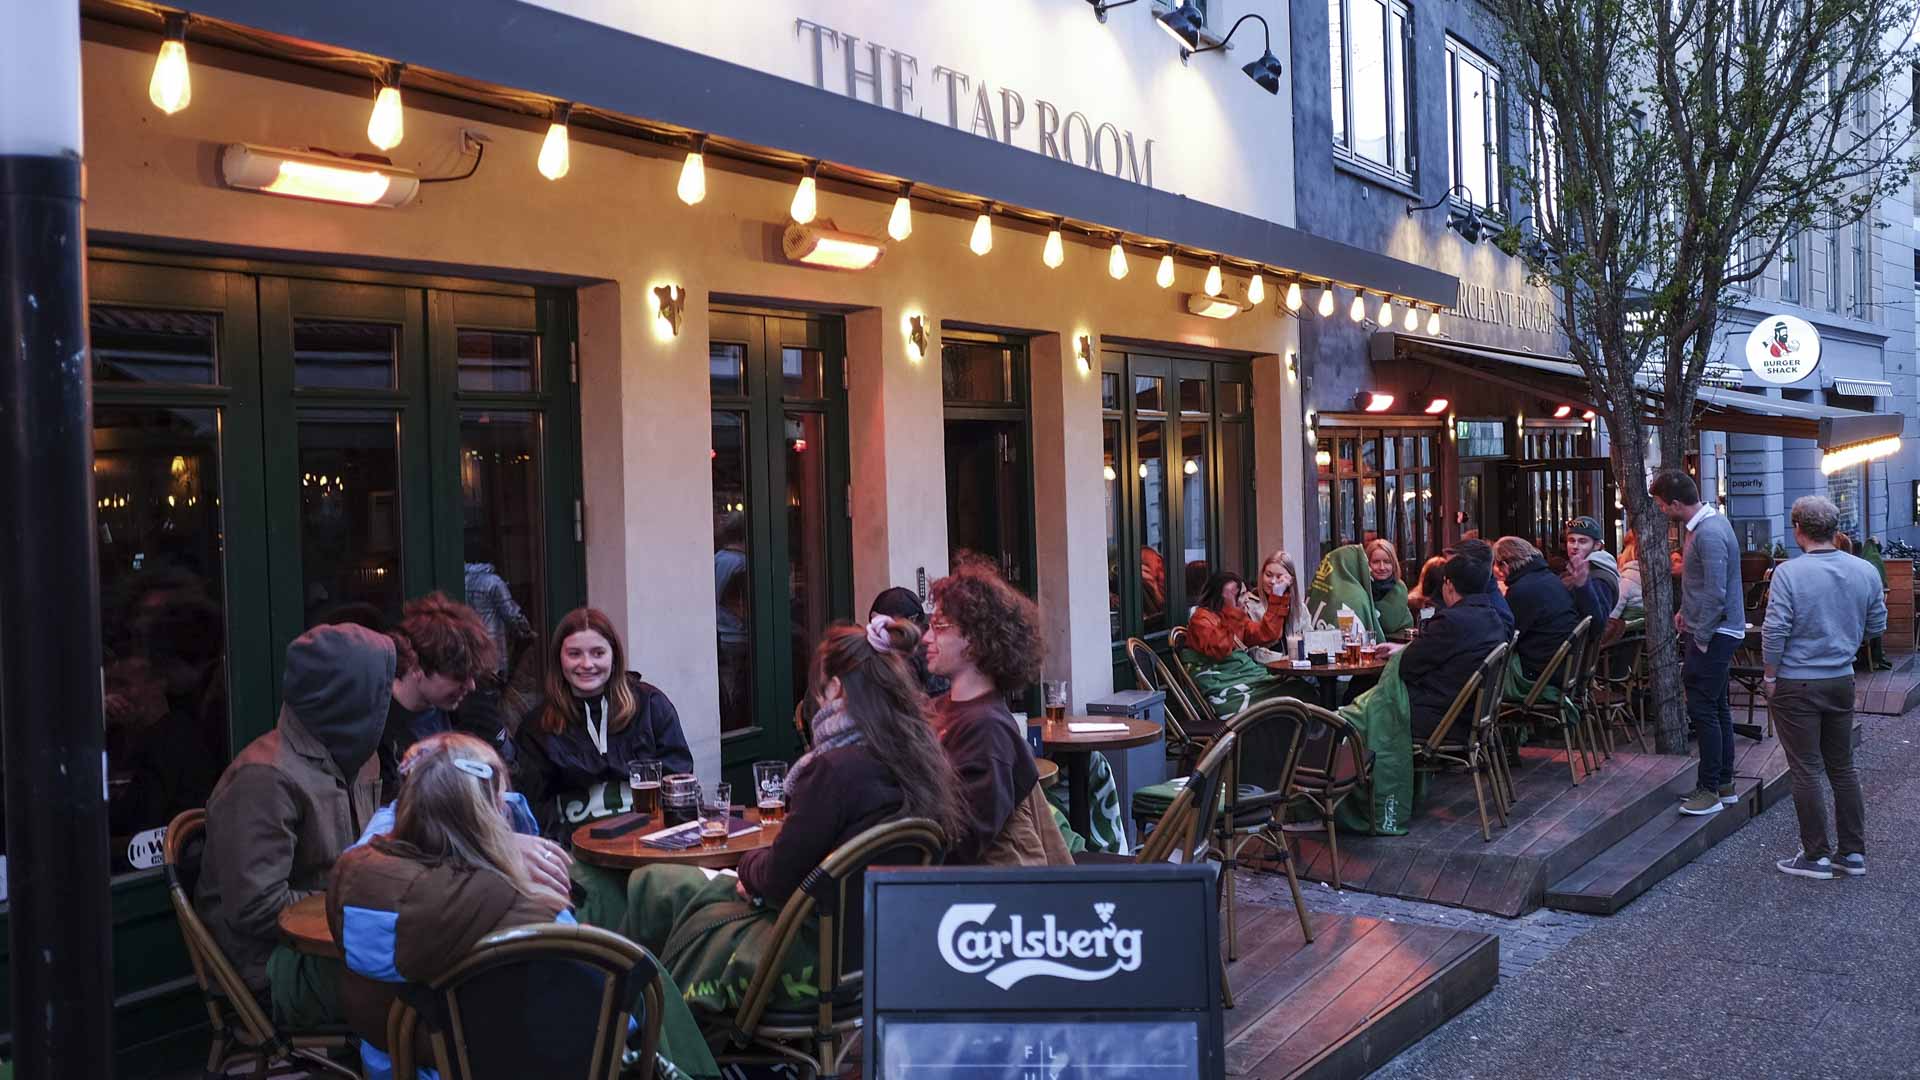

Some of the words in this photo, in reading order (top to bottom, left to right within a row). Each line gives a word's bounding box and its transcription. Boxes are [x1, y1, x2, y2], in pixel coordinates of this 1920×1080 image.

[795, 17, 922, 118] THE
[933, 65, 1025, 146] TAP
[1034, 99, 1156, 188] ROOM
[1763, 359, 1801, 367] BURGER
[1767, 366, 1798, 374] SHACK
[937, 903, 1144, 990] Carlsberg
